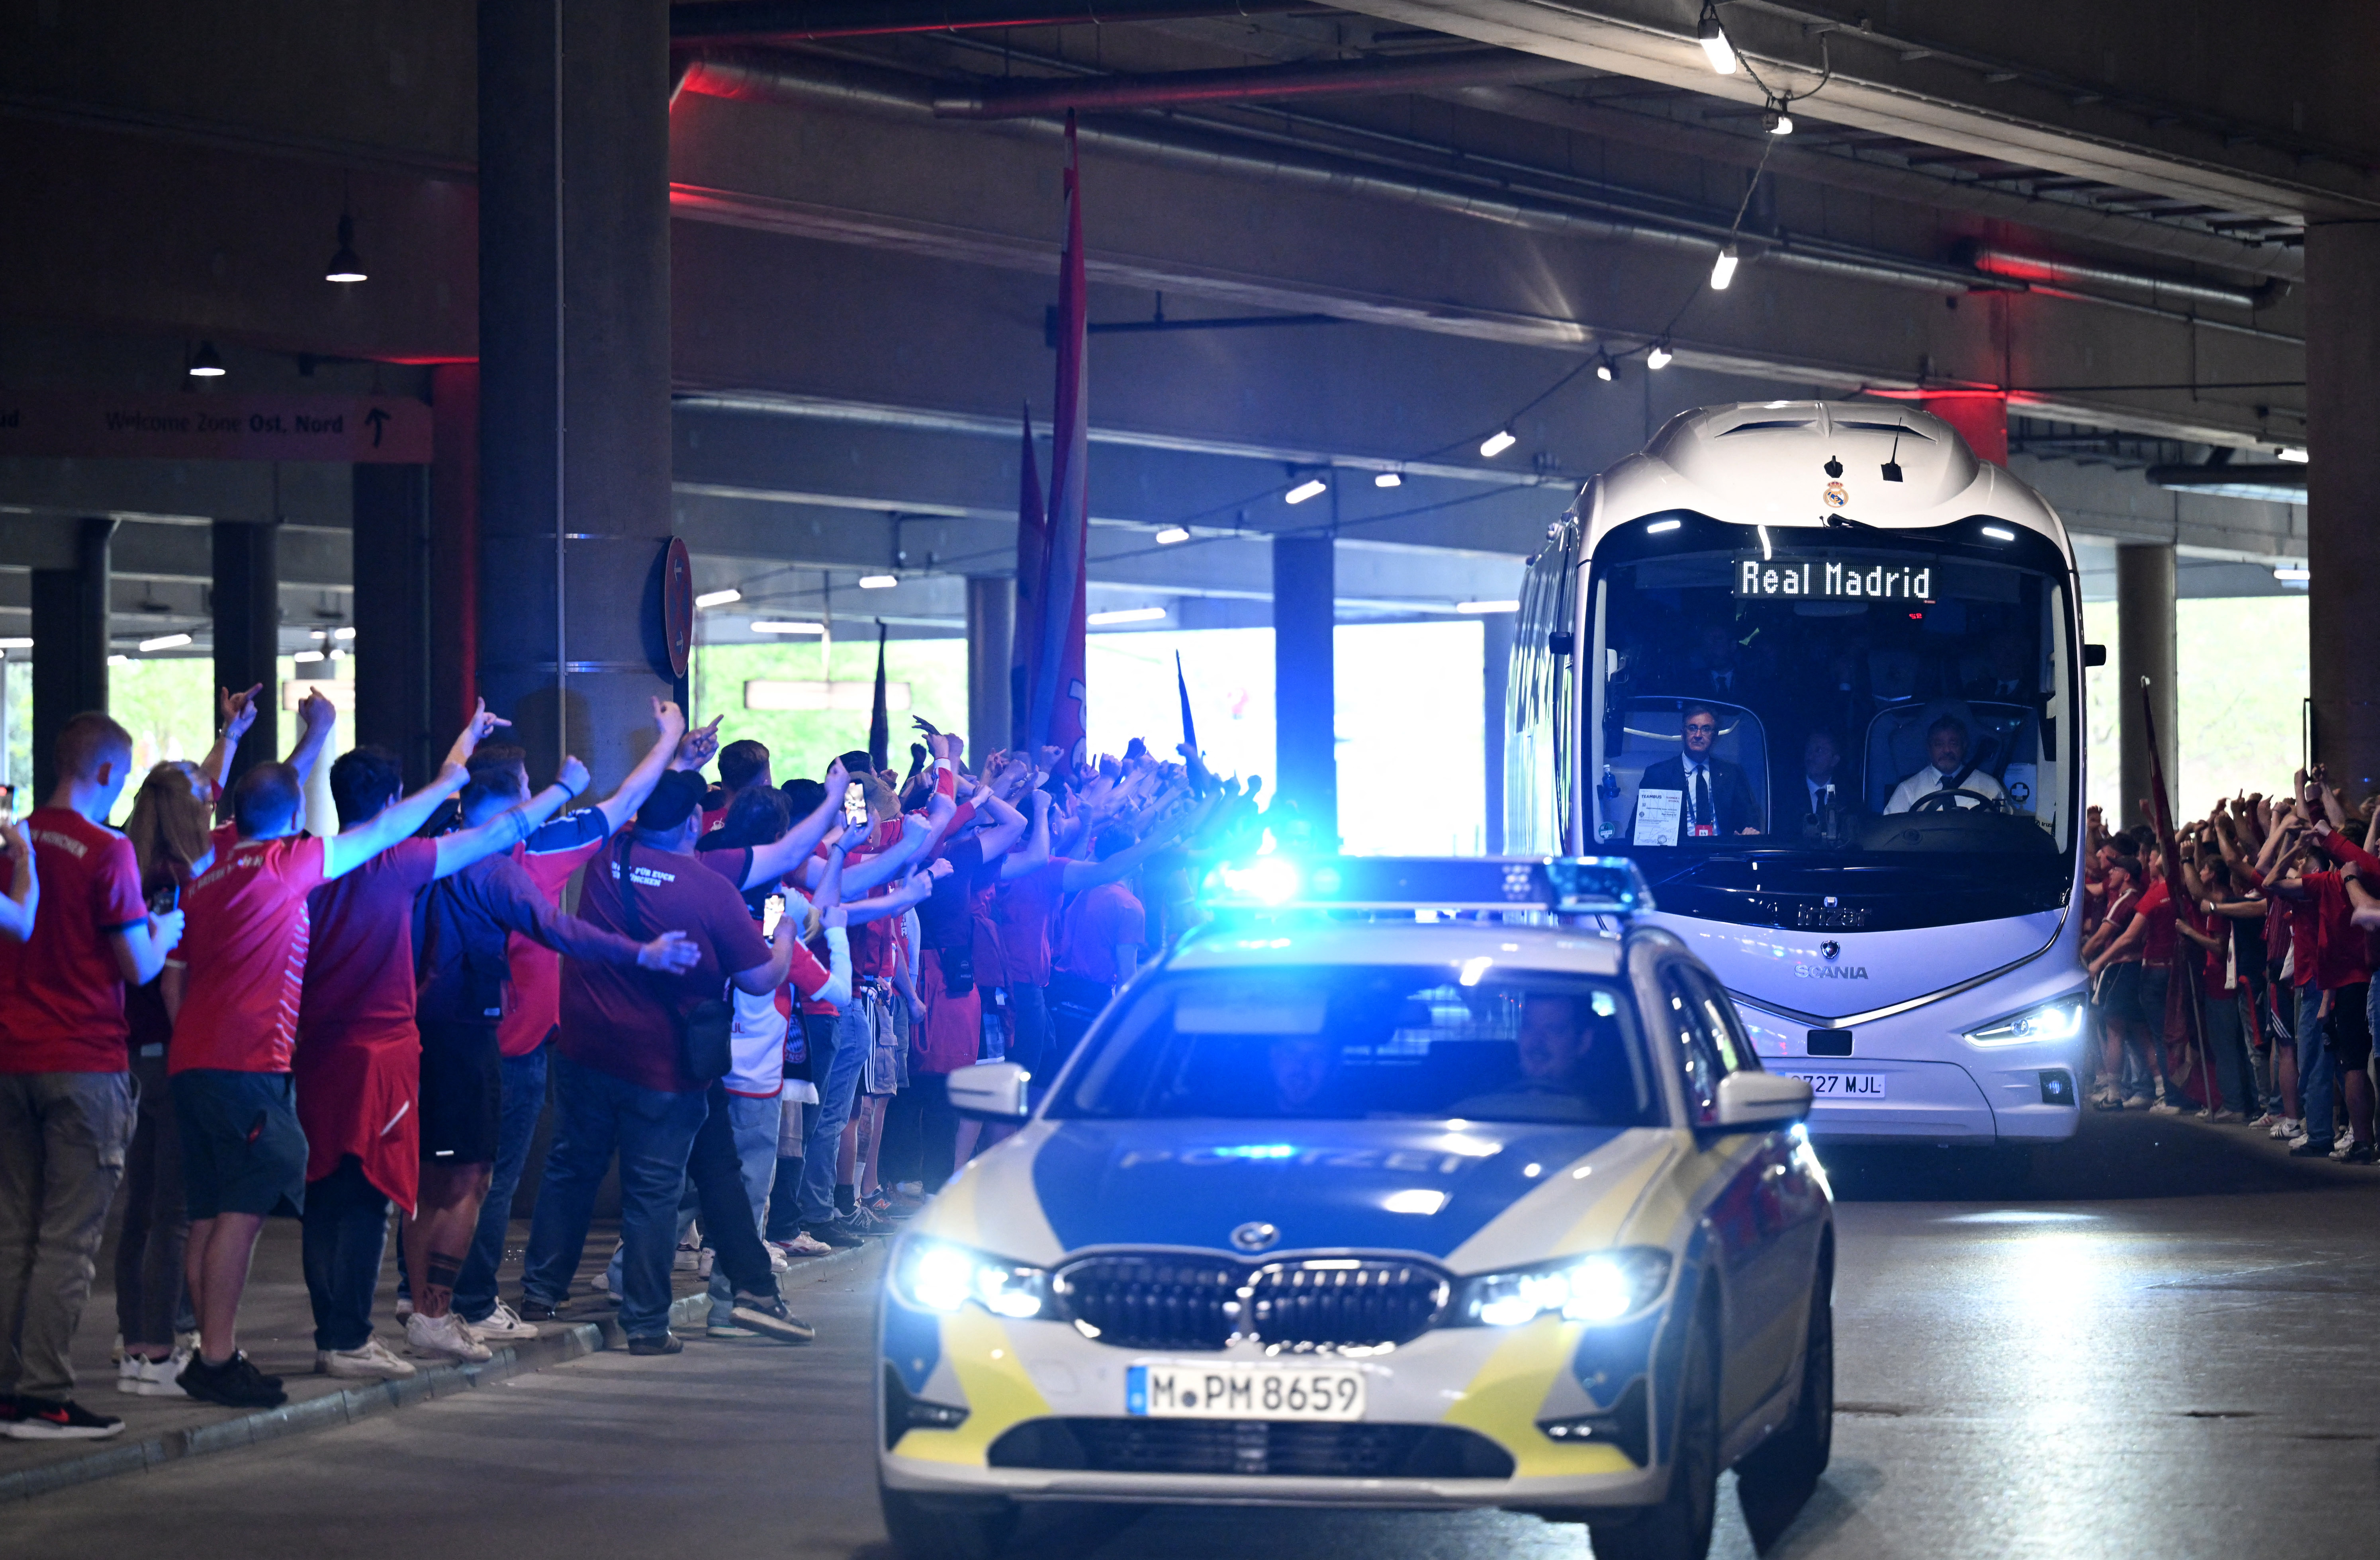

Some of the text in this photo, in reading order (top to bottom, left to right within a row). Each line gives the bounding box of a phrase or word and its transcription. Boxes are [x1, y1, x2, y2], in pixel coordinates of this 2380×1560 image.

[105, 410, 343, 433] Welcome Zone Ost, Nord
[1743, 561, 1929, 598] Real Madrid
[1794, 964, 1869, 979] SCANIA
[1791, 1075, 1881, 1093] 727 MJL
[1153, 1375, 1358, 1411] M PM 8659
